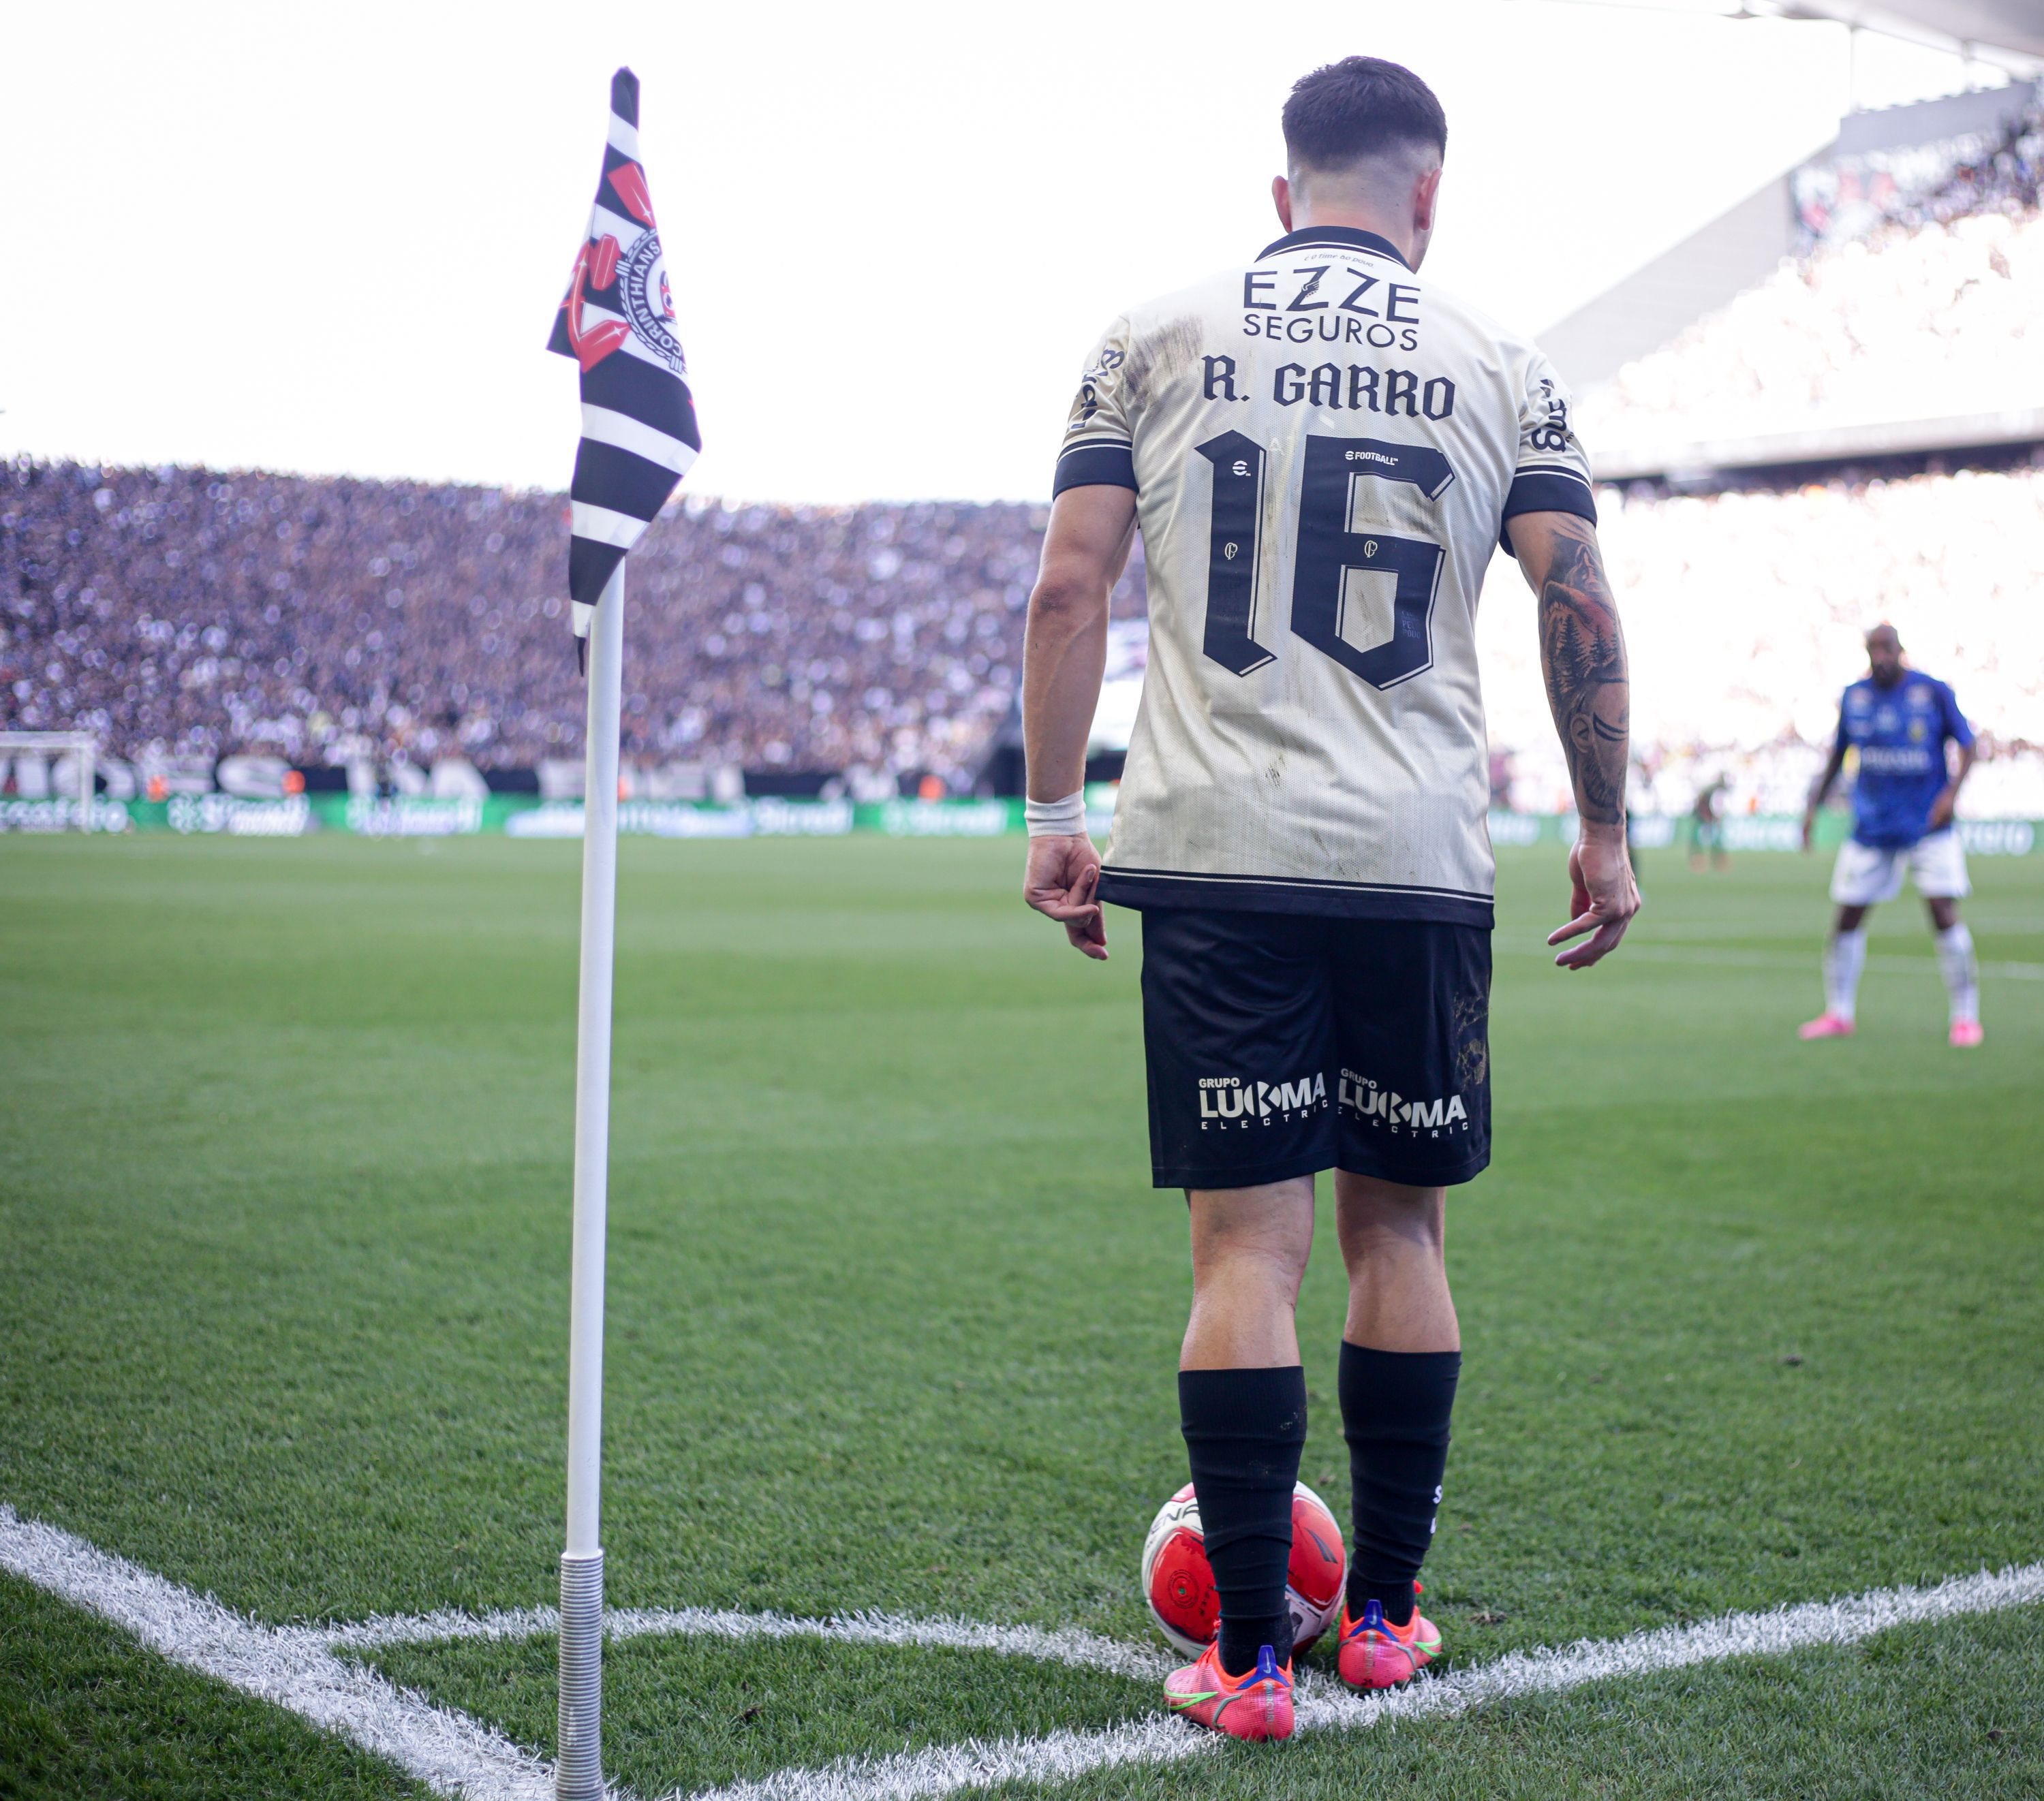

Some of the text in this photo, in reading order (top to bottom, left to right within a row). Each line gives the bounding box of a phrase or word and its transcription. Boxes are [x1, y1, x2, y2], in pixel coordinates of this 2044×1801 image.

[630, 240, 682, 357] CORINTHIANS
[1243, 266, 1421, 324] EZZE
[1243, 313, 1418, 351] SEGUROS
[1201, 355, 1455, 421] R. GARRO
[1193, 429, 1455, 691] 16
[1198, 1077, 1240, 1089] GRUPO
[1340, 1068, 1377, 1089] GRUPO
[1201, 1099, 1328, 1129] ELECTRIC
[1337, 1106, 1468, 1138] ELECTRIC
